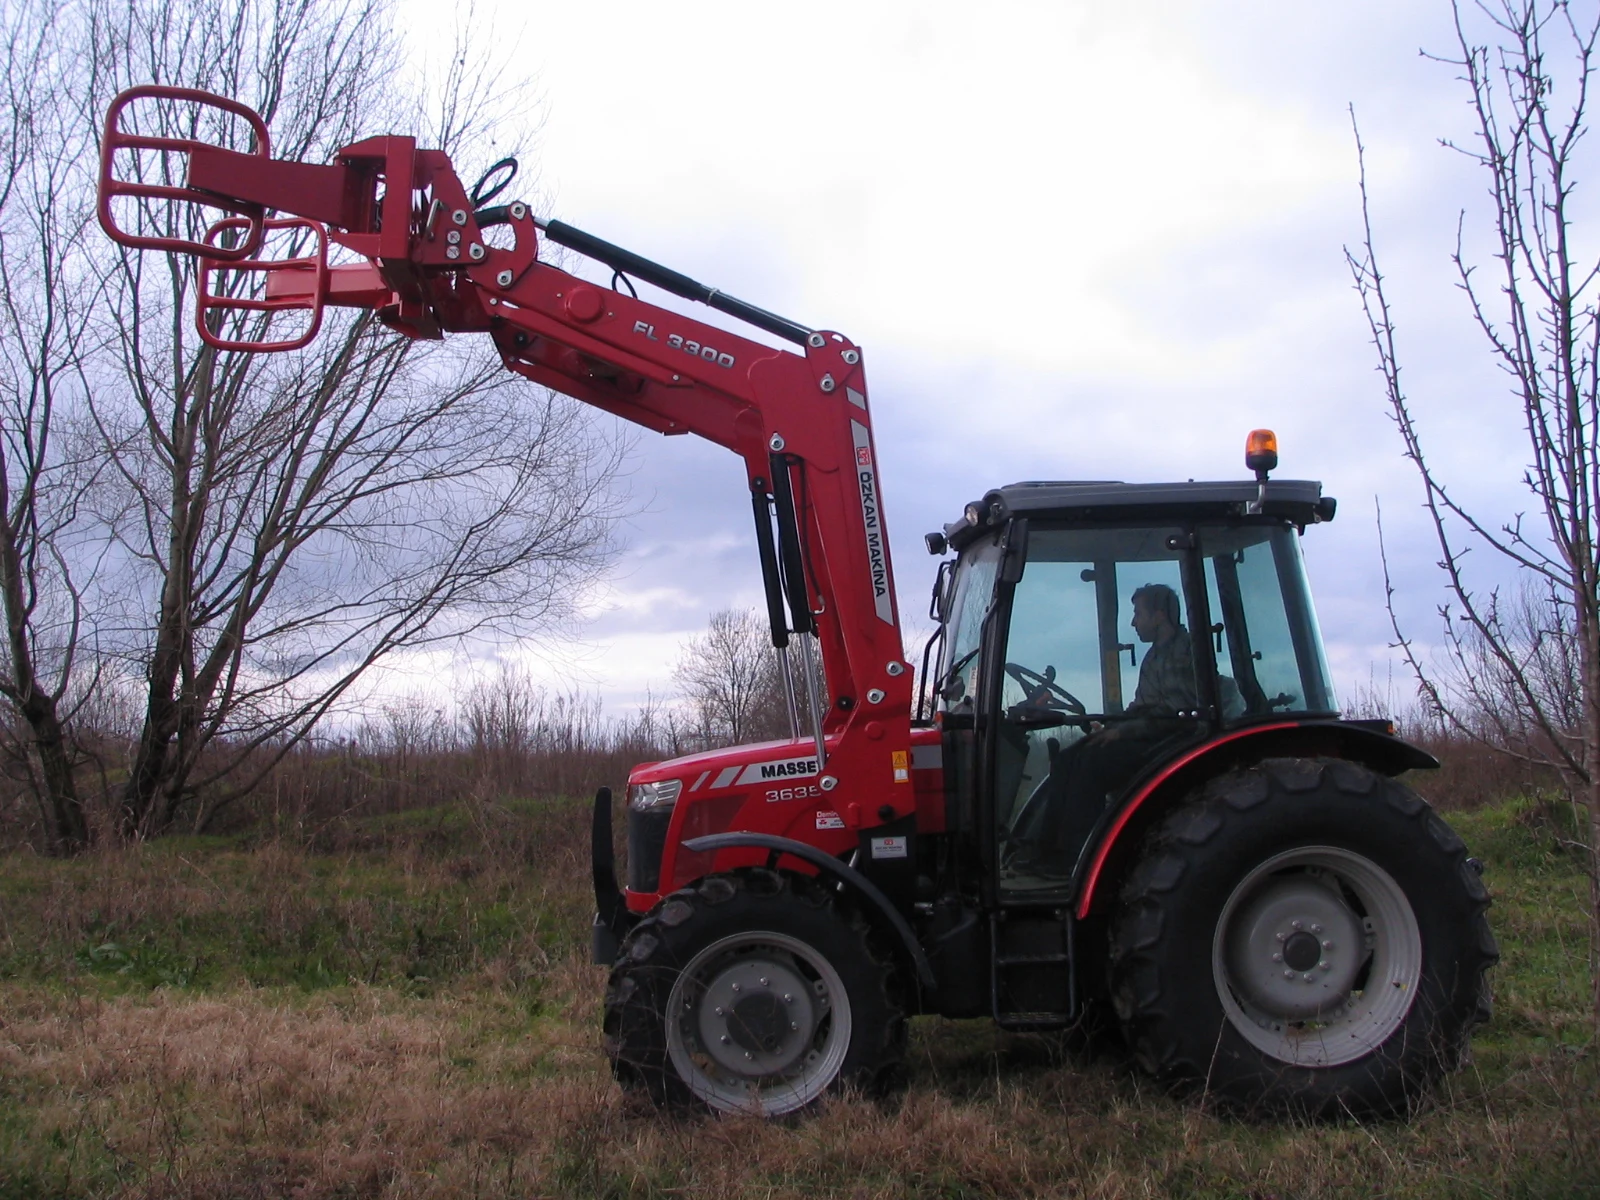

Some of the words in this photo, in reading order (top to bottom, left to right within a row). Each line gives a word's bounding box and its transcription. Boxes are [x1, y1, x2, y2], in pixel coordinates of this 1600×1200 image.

[633, 320, 659, 341] FL
[666, 333, 735, 369] 3300
[860, 471, 877, 528] ÖZKAN
[761, 760, 819, 778] MASSE
